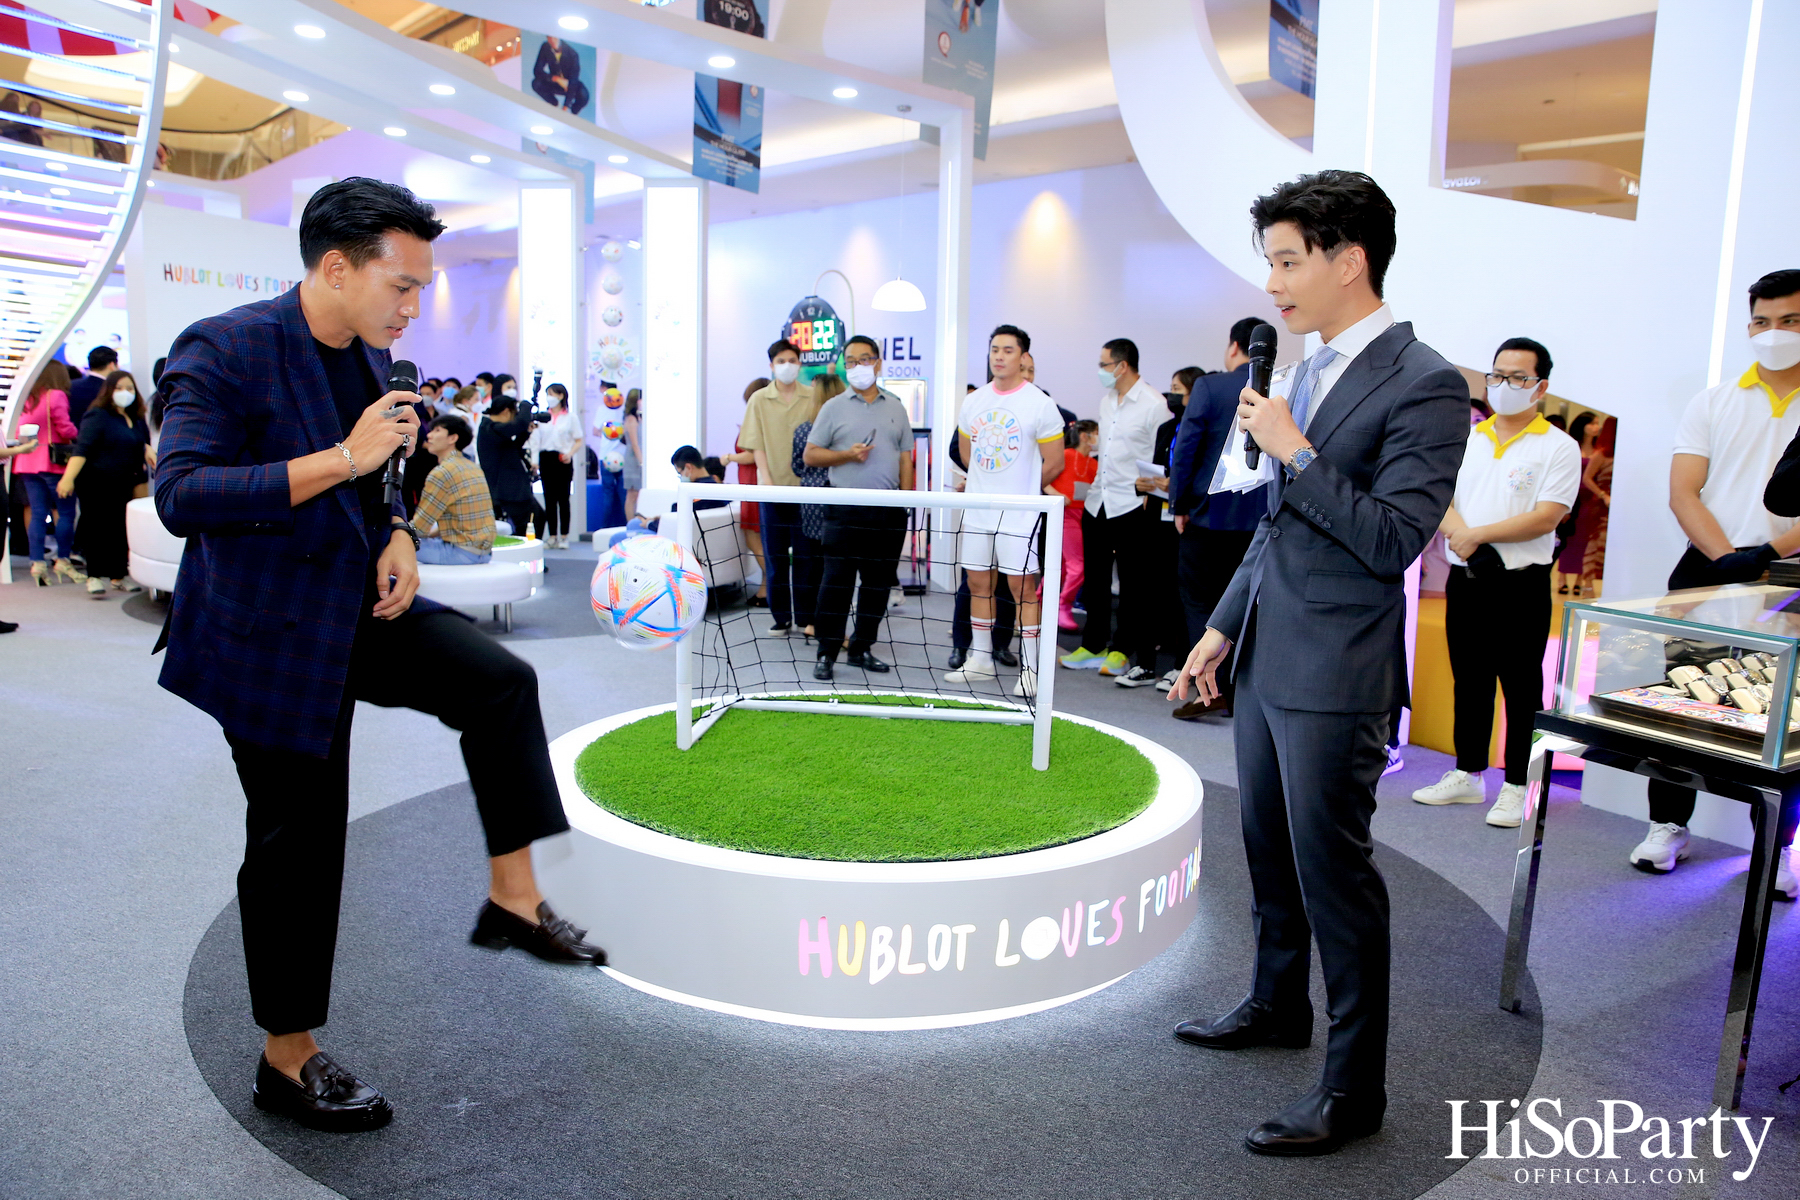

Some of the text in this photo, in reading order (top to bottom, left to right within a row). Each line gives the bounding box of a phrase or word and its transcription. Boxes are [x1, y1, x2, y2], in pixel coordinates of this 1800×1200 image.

[164, 263, 211, 285] HUBLOT
[265, 276, 300, 293] FOOT
[790, 319, 835, 351] 2022
[887, 366, 921, 377] SOON
[799, 915, 976, 985] HUBLOT
[995, 896, 1126, 967] LOVES
